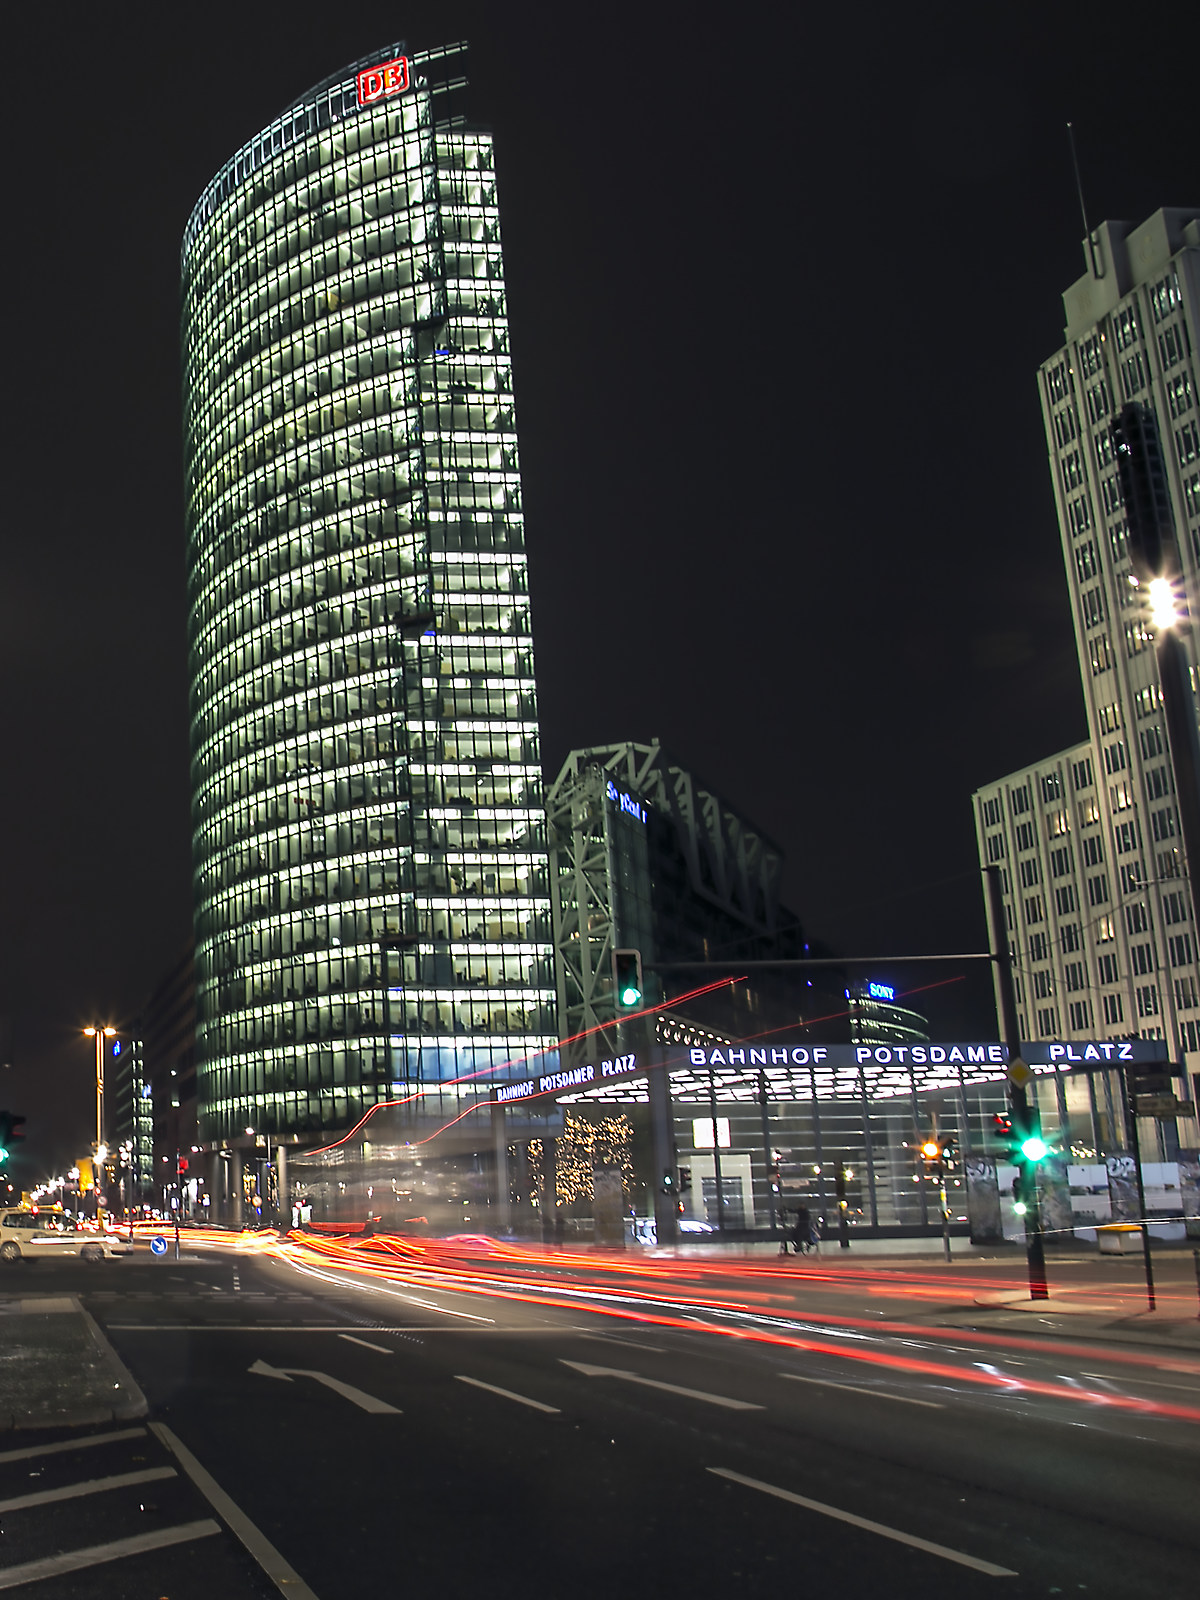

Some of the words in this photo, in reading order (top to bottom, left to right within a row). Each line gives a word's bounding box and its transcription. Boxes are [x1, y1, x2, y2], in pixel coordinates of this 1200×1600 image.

[363, 64, 404, 99] DB
[869, 982, 895, 1001] SONY
[689, 1047, 828, 1066] BAHNHOF
[856, 1045, 1009, 1064] POTSDAME
[1048, 1042, 1135, 1062] PLATZ
[496, 1080, 535, 1102] BAHNHOF
[539, 1065, 595, 1092] POTSDAMER
[601, 1053, 636, 1077] PLATZ
